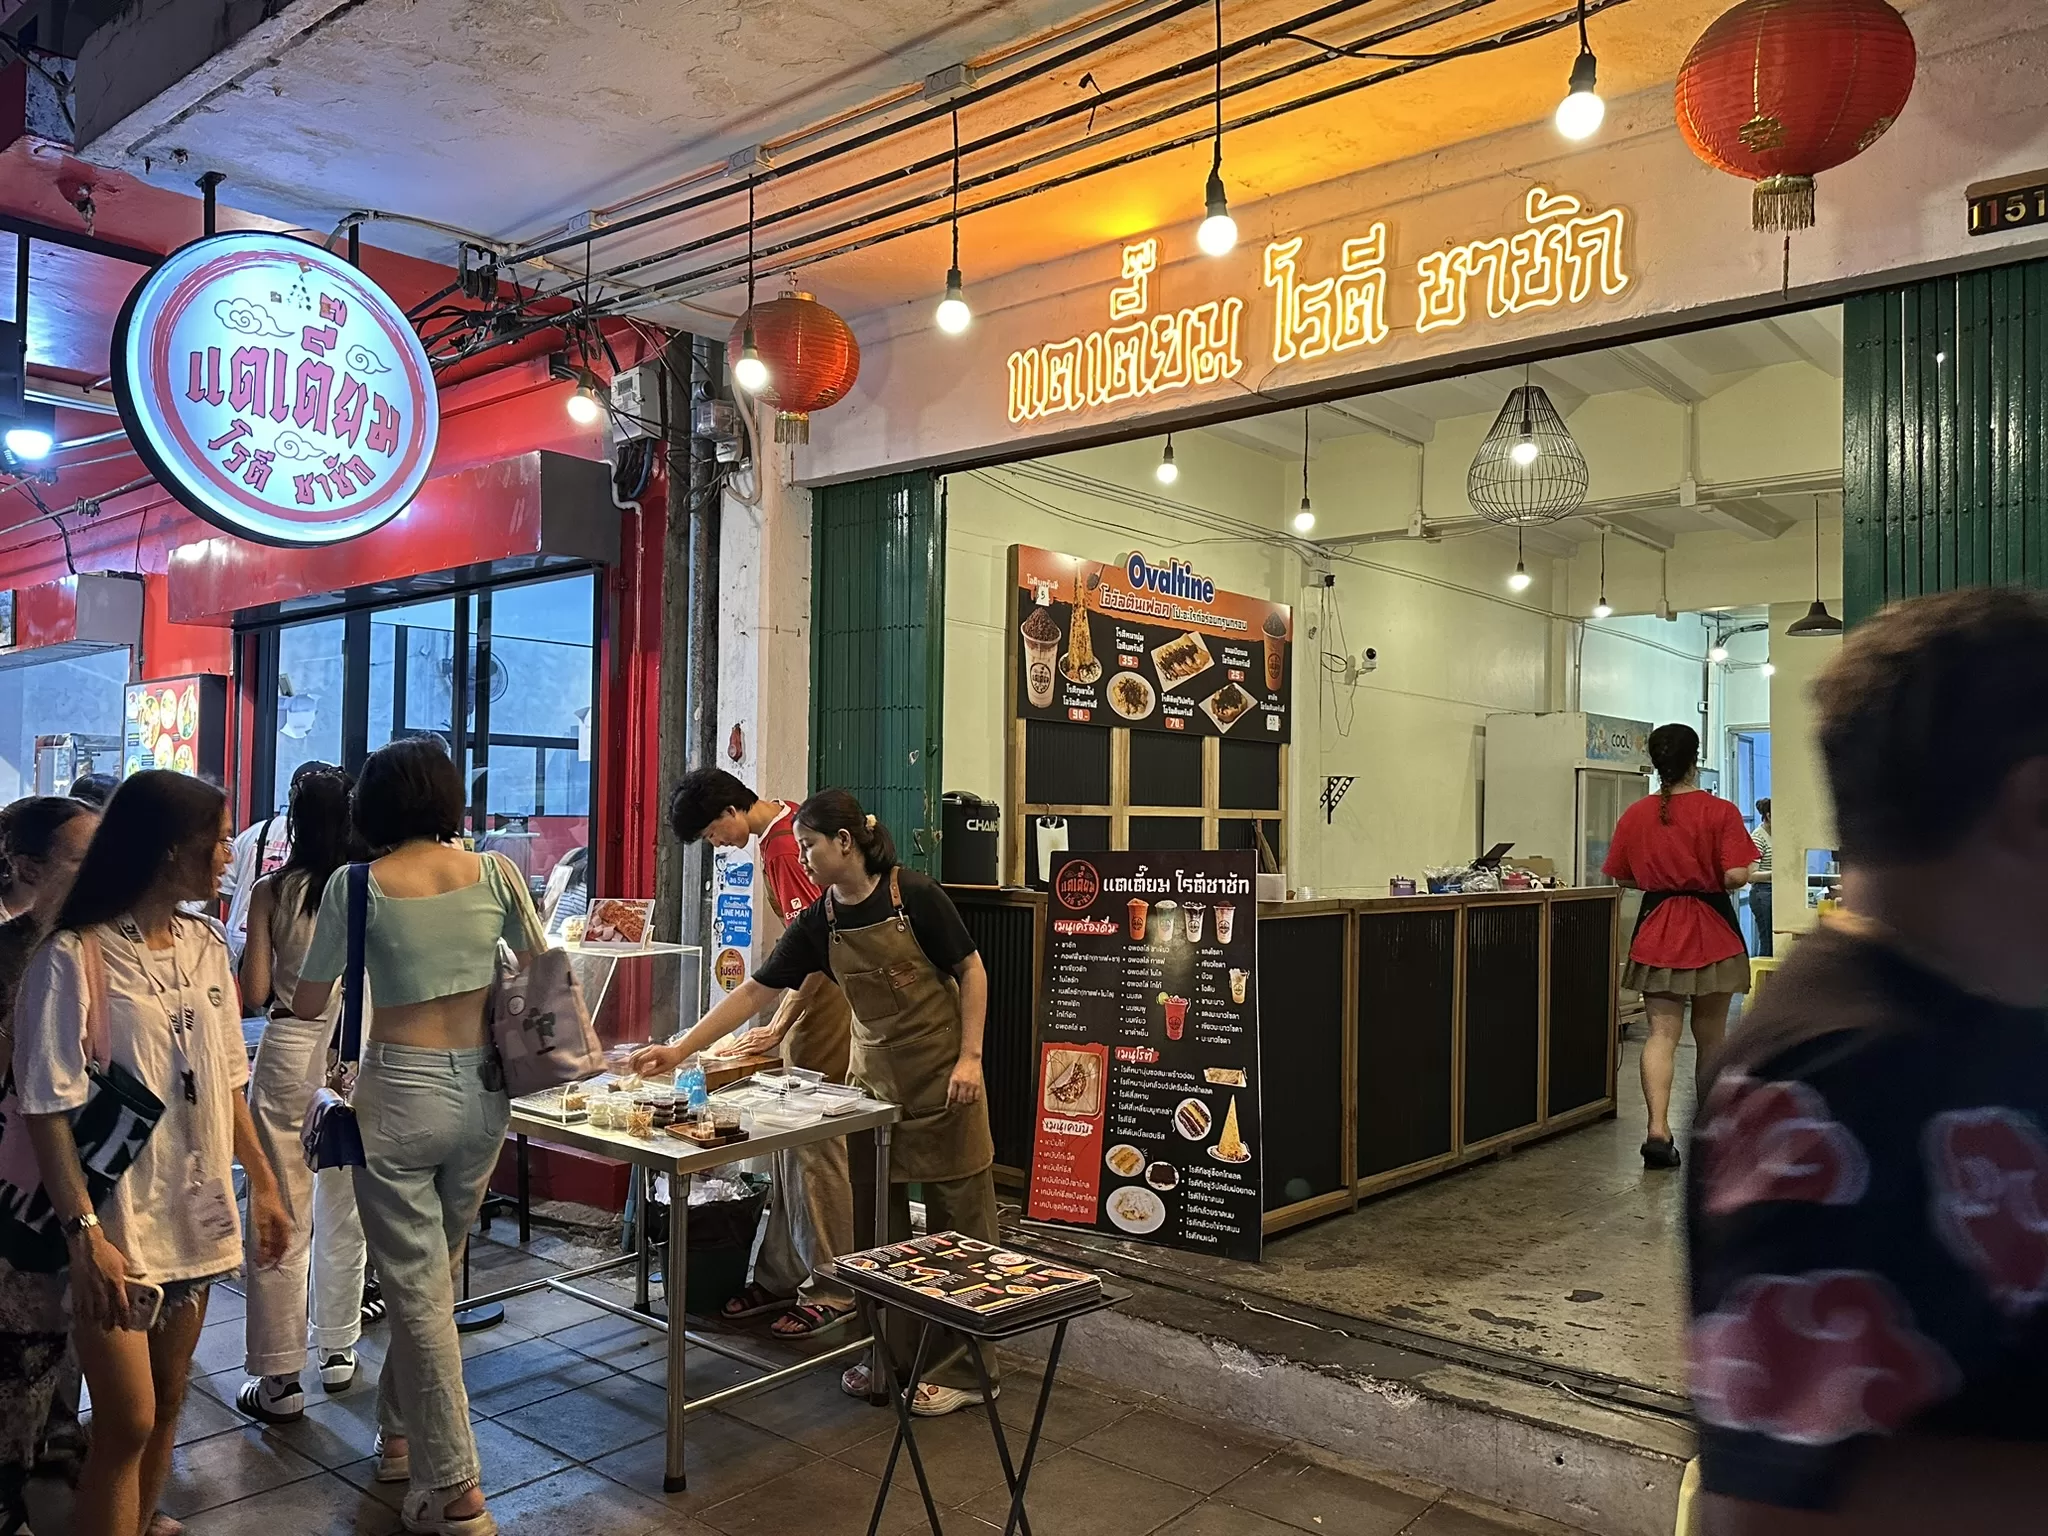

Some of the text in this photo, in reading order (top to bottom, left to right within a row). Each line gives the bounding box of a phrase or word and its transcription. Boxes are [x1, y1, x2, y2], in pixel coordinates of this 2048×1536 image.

[1265, 222, 1390, 363] โรตี
[1416, 187, 1630, 334] ชาชัก
[208, 419, 376, 504] โรตี ชาชัก
[1127, 554, 1214, 603] Ovaltine
[1103, 865, 1170, 893] แตเตี๊ยม
[720, 908, 750, 918] LINE MAN
[1054, 915, 1115, 936] เมนูเครื่องดื่ม
[1117, 1046, 1154, 1064] เมนูโรตี
